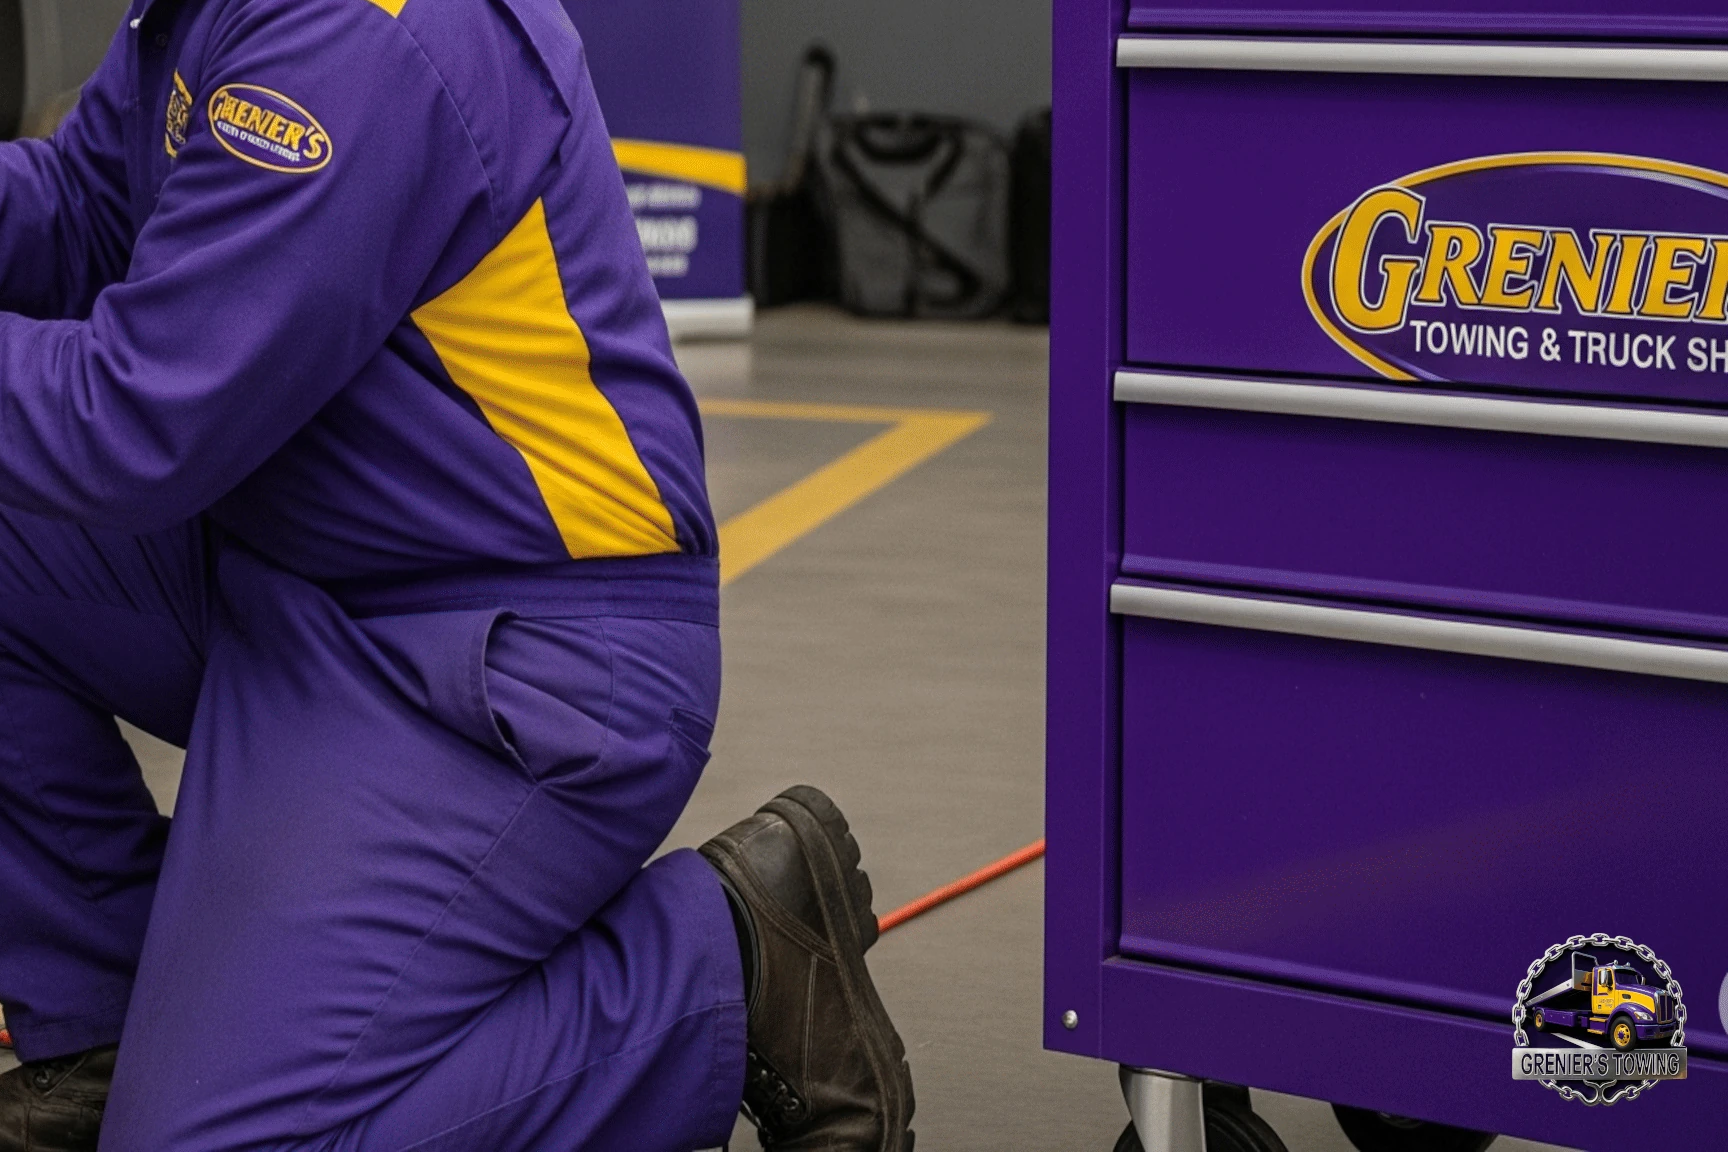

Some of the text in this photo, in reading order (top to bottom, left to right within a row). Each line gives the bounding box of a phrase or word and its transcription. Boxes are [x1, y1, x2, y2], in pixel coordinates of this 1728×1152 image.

[1409, 319, 1529, 361] TOWING
[1539, 327, 1561, 363] &
[1568, 330, 1677, 371] TRUCK
